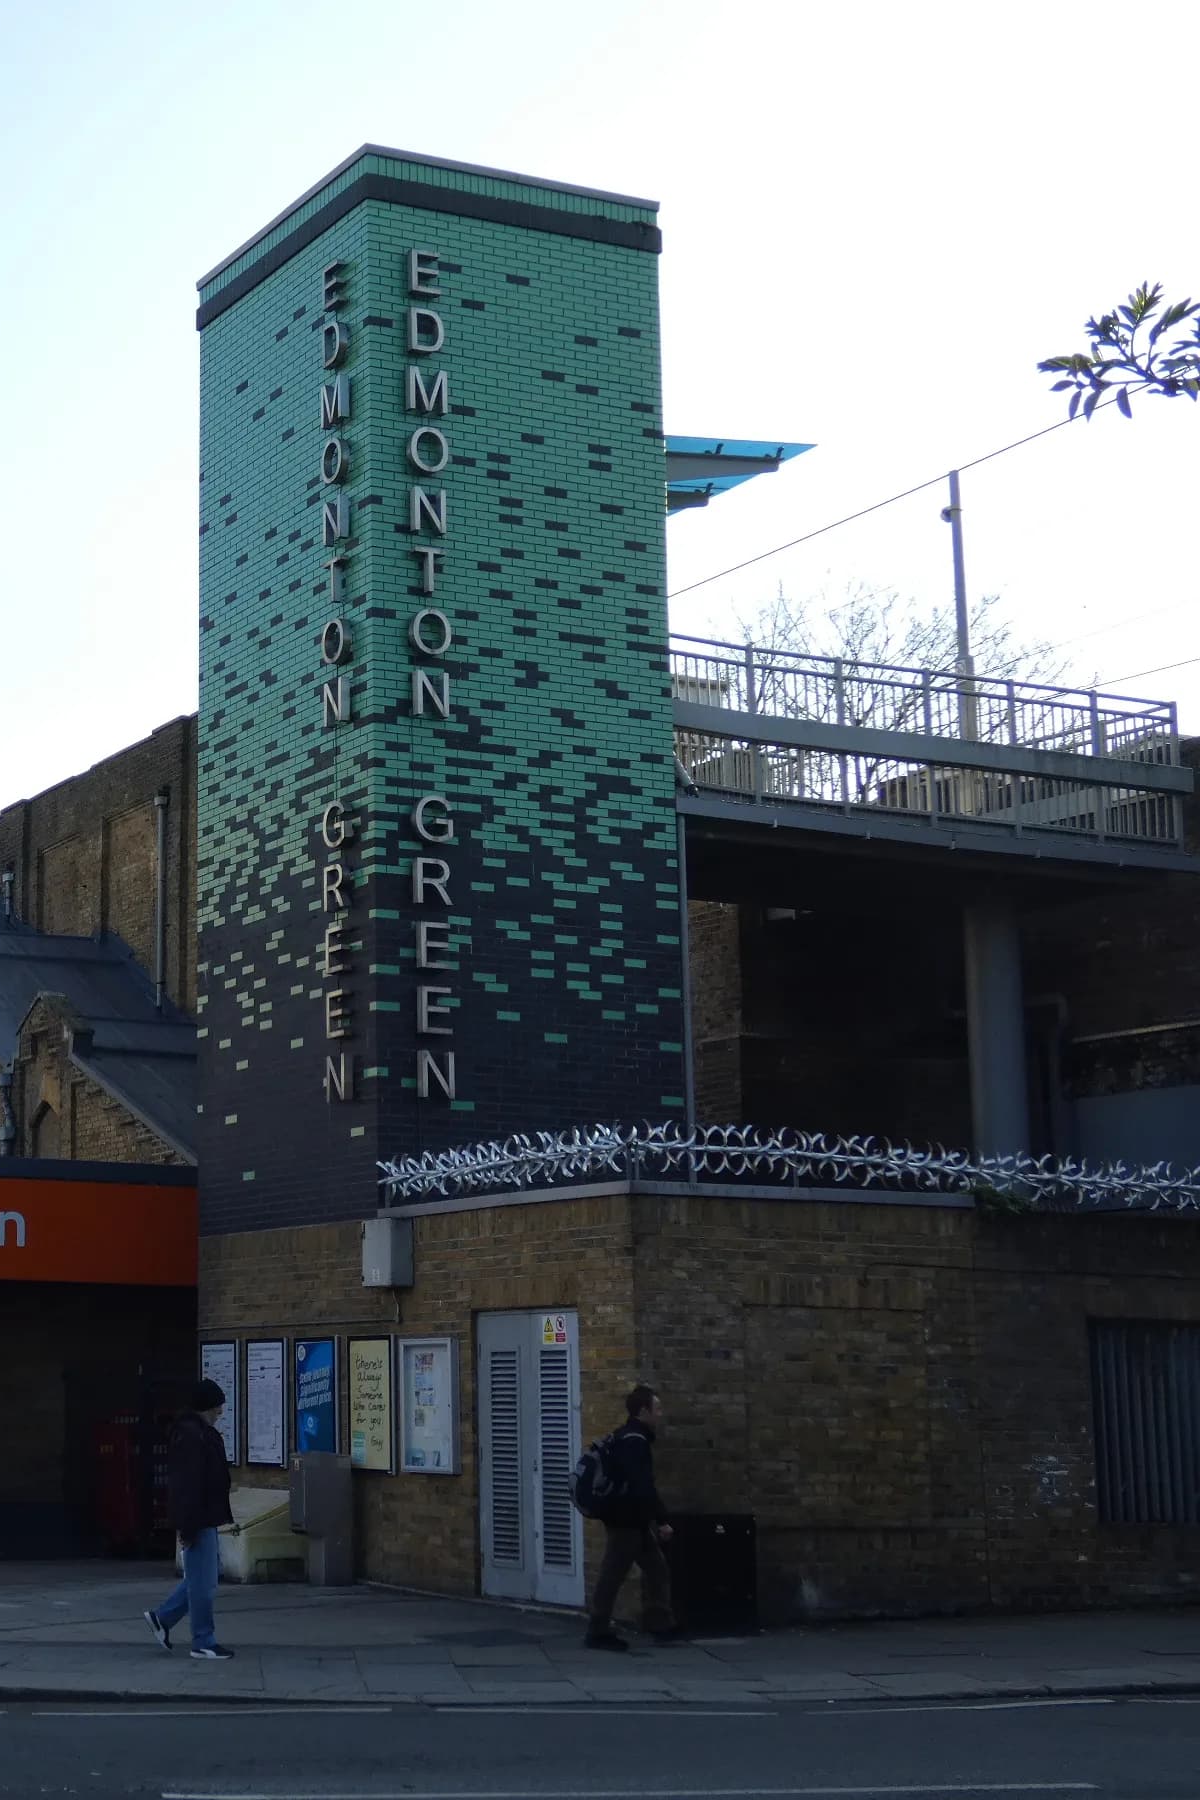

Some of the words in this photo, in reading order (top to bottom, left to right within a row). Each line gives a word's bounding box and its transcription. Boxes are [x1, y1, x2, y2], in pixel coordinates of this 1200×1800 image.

[320, 258, 353, 728] EDMONTON
[405, 249, 452, 719] EDMONTON
[322, 801, 354, 1104] GREEN
[412, 795, 456, 1100] GREEN
